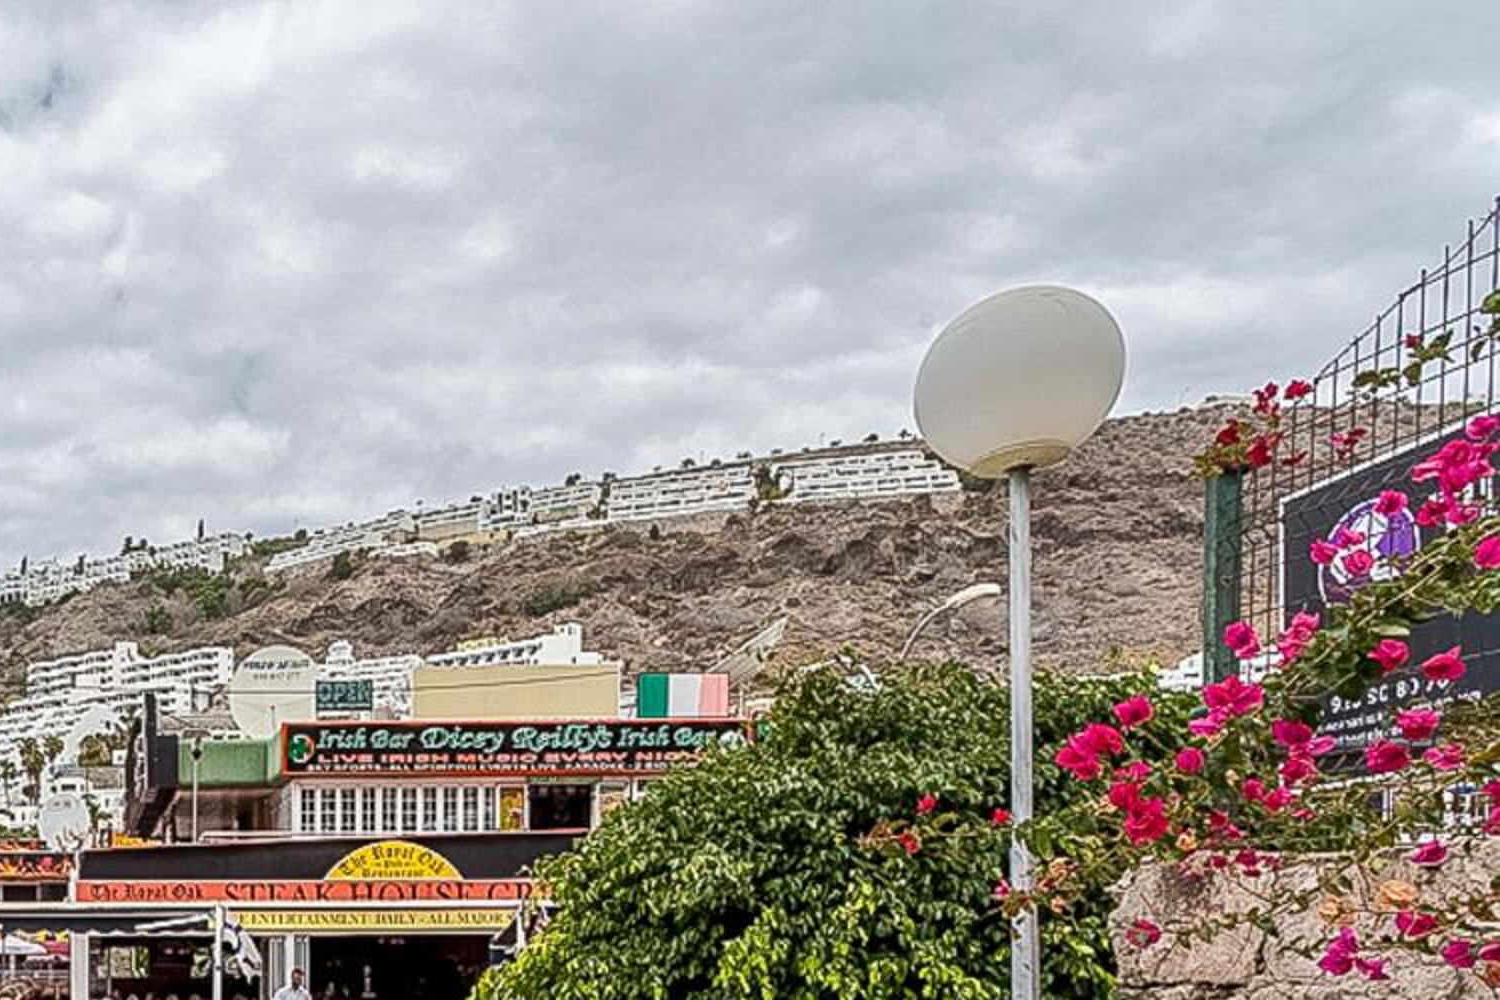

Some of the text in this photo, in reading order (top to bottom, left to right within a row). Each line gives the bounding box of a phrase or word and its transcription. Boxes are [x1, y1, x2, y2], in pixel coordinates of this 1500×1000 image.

[318, 683, 370, 702] OPEN
[317, 724, 716, 752] Irish Bar Dicey Reilly's Irish Bar
[318, 753, 373, 763] LIVE
[381, 753, 449, 763] IRISH
[457, 753, 538, 763] MUSIC
[544, 752, 627, 763] EVERY
[339, 845, 446, 876] The Royal Oak
[90, 884, 119, 900] The
[125, 884, 167, 901] Royal
[171, 884, 203, 900] Oak
[225, 883, 333, 900] STEAK
[350, 882, 474, 900] HOUSE
[251, 913, 367, 925] ENTERTAINMENT
